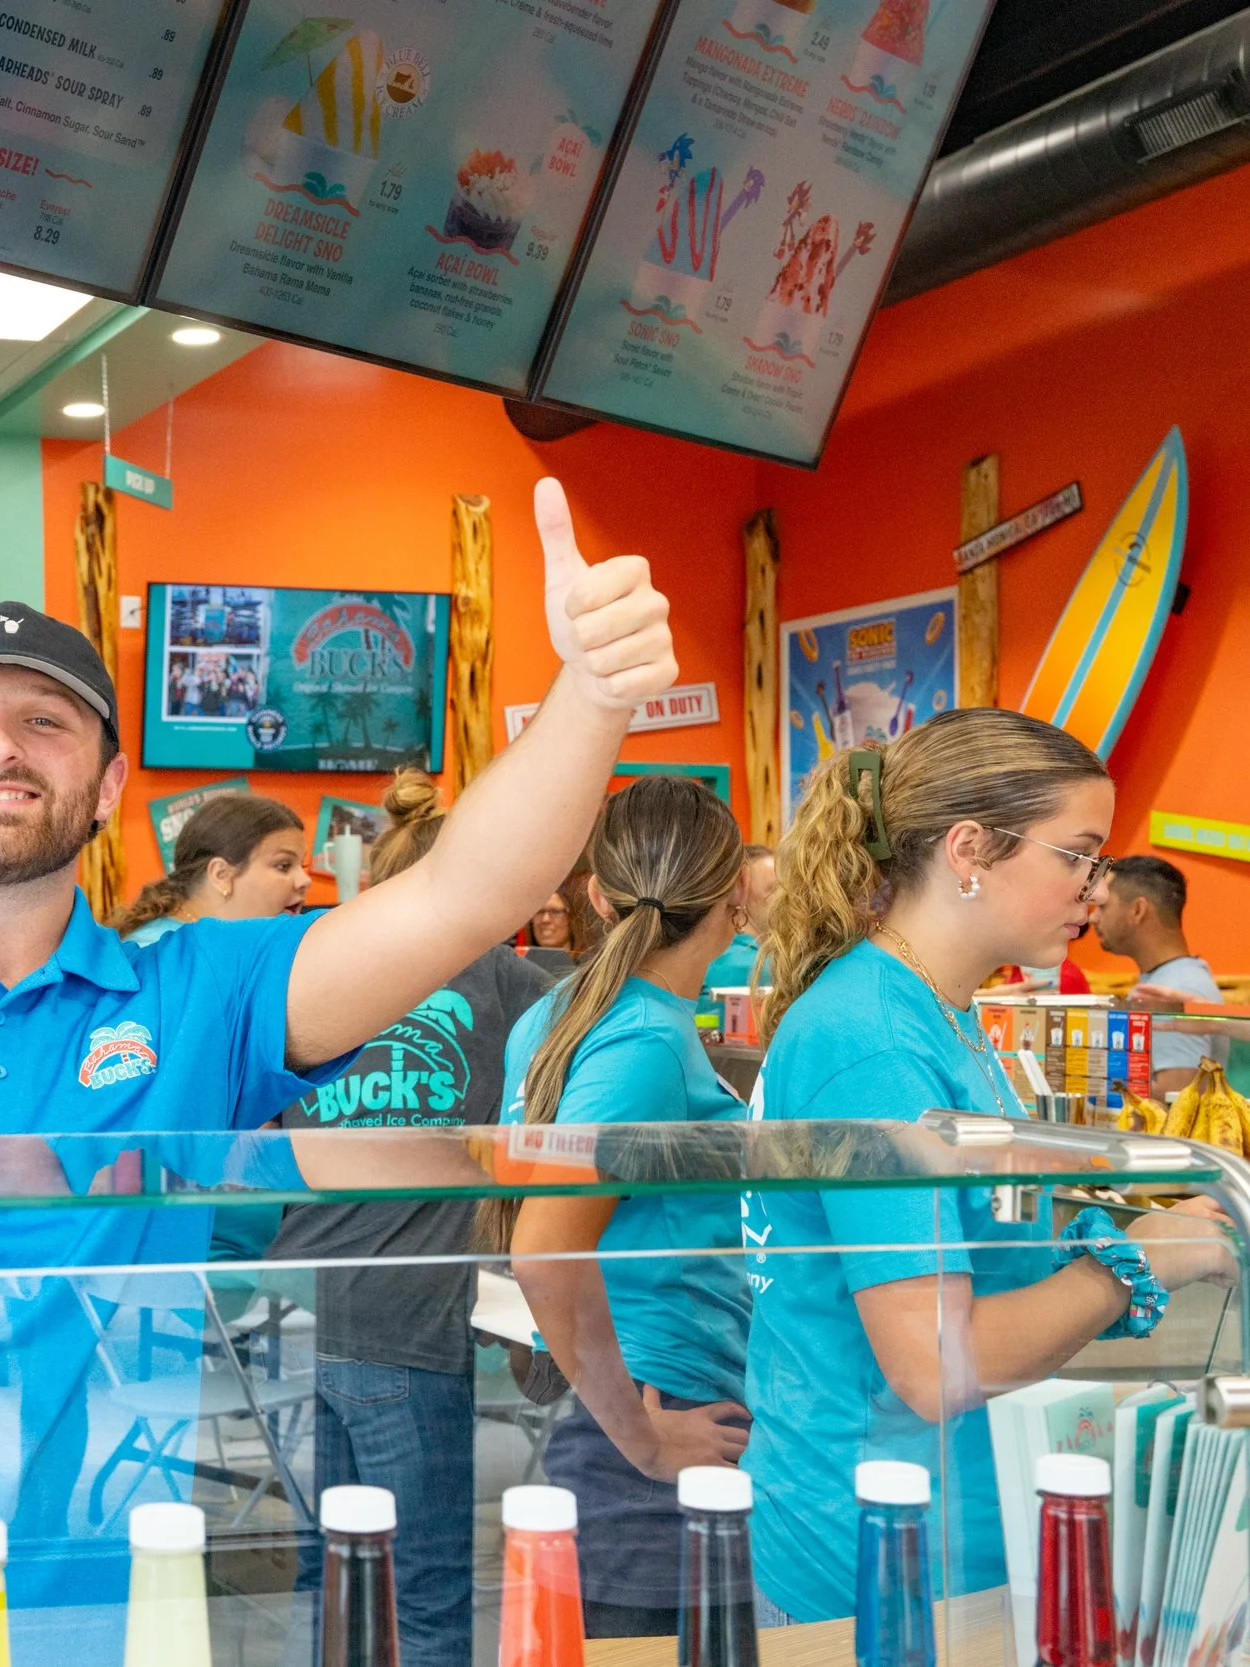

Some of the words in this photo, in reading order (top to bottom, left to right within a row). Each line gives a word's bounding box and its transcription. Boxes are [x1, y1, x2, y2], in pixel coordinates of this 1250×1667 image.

[160, 28, 176, 42] .89
[67, 37, 97, 60] MILK
[148, 66, 164, 80] .89
[694, 35, 762, 79] MANGONADA
[762, 64, 810, 98] EXTREME
[54, 74, 86, 99] SOUR
[88, 86, 125, 110] SPRAY
[16, 101, 62, 125] Cinnamon
[63, 115, 90, 135] Sugar,
[92, 126, 114, 141] Sour
[548, 156, 577, 177] BOWL
[380, 181, 403, 201] 1.79
[40, 199, 71, 216] Everest
[264, 197, 351, 240] DREAMSICLE
[33, 225, 60, 245] 8.29
[254, 221, 313, 254] DELIGHT
[314, 239, 344, 262] SNO
[230, 240, 278, 264] Dreamsicle
[280, 255, 305, 271] flavor
[466, 262, 500, 286] BOWL
[410, 299, 441, 314] coconut
[628, 320, 660, 344] SONIC
[660, 327, 681, 349] SNO
[849, 621, 894, 650] SONIC
[645, 700, 664, 718] ON
[669, 696, 703, 716] DUTY
[85, 1043, 149, 1071] Bahama
[89, 1058, 153, 1089] BUCK'S
[316, 1071, 456, 1122] BUCK'S
[387, 1114, 406, 1126] Ice
